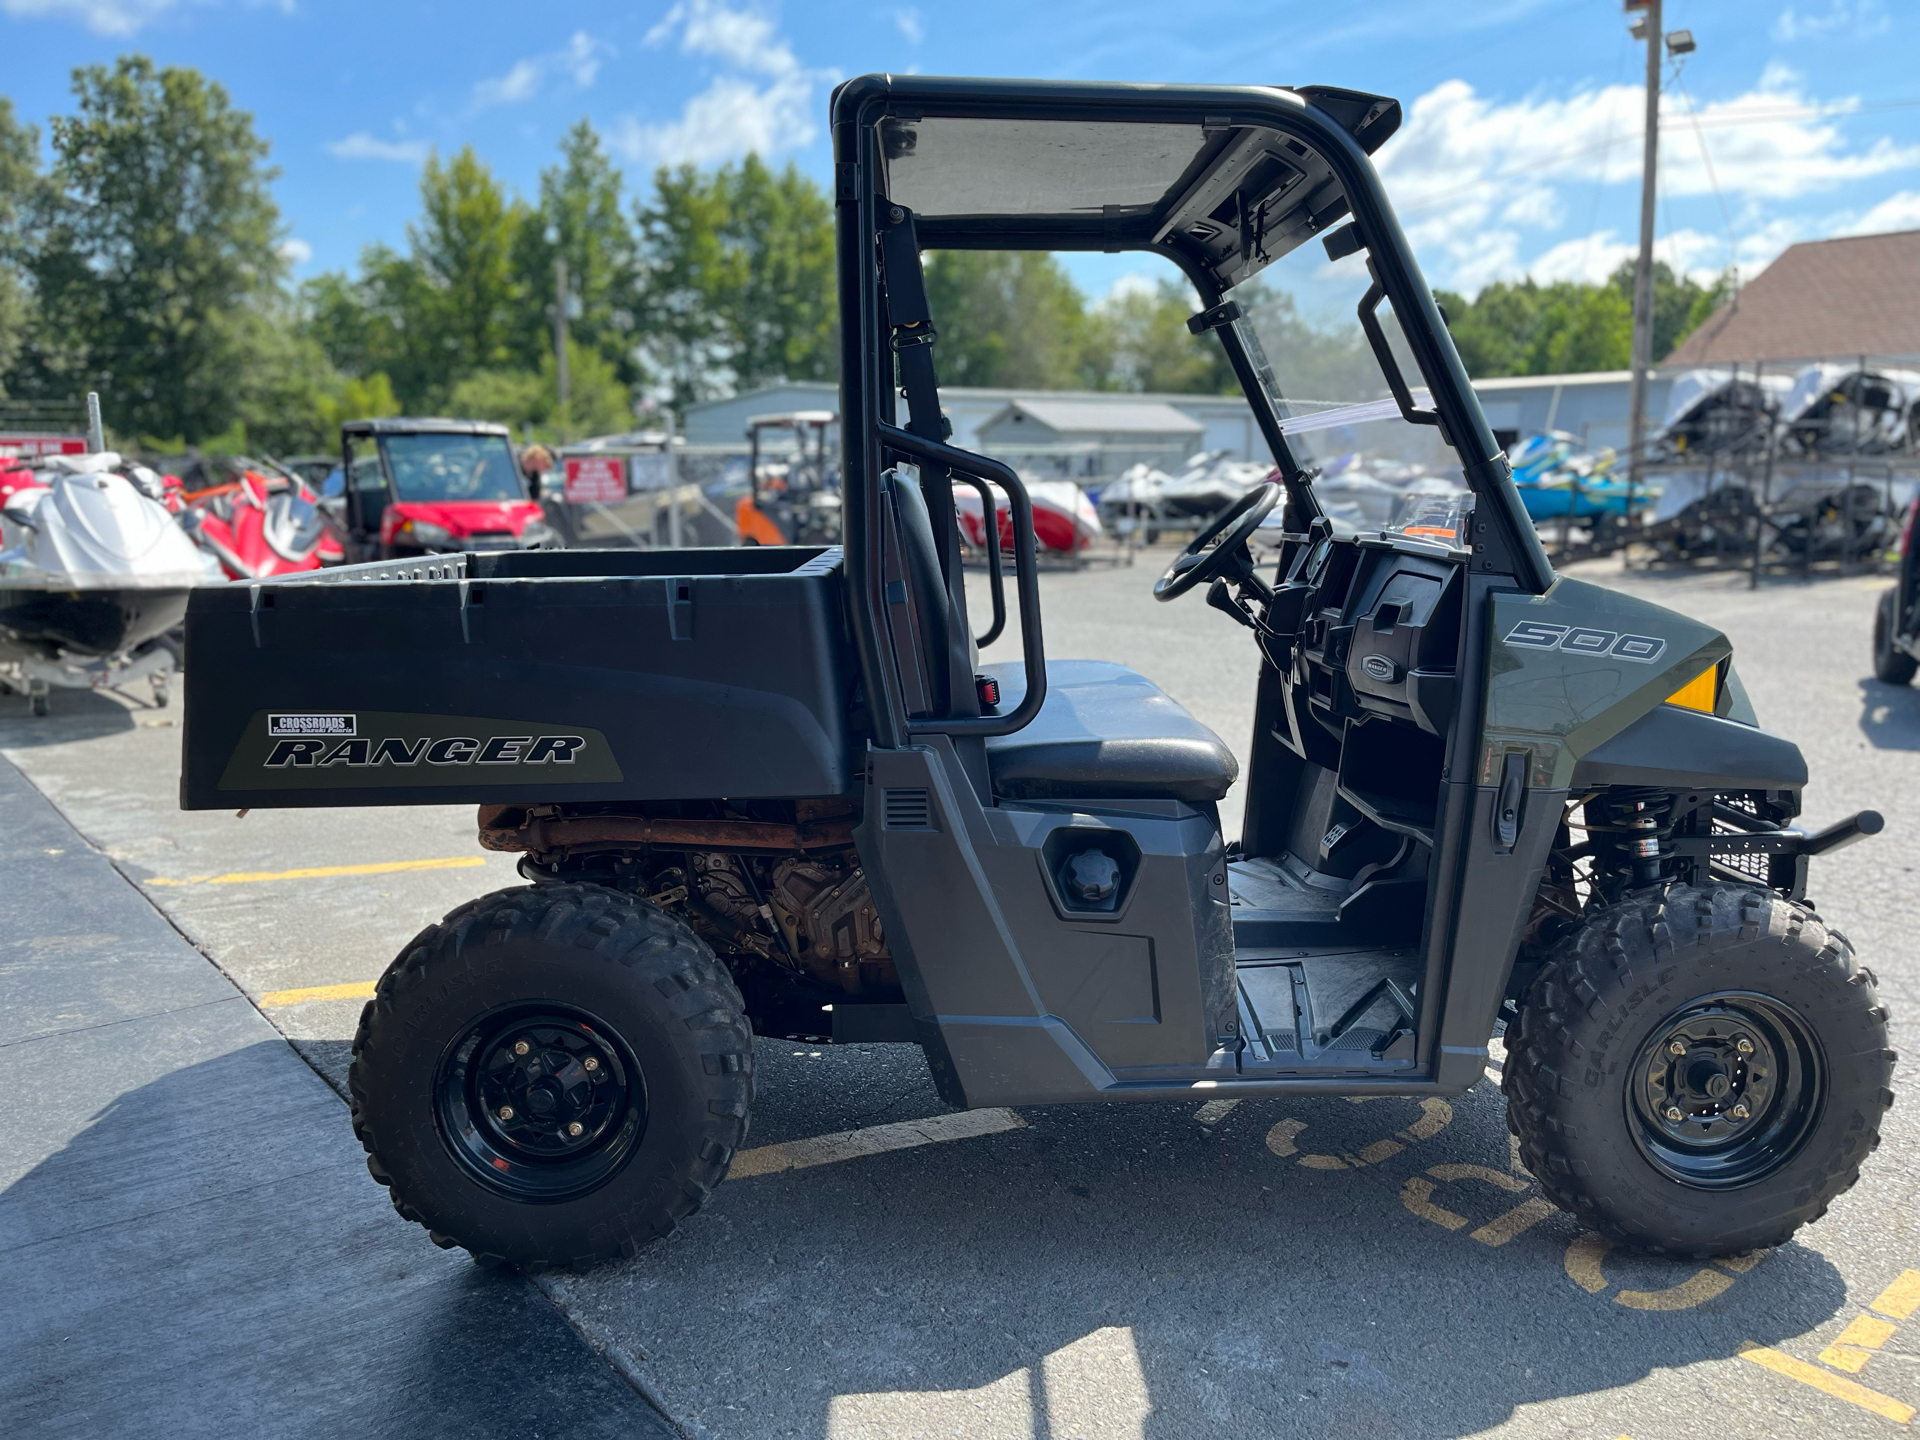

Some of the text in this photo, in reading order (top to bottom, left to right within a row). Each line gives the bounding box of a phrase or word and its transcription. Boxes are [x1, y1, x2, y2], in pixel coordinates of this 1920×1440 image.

[1502, 620, 1667, 665] 500
[279, 717, 345, 728] CROSSROADS
[263, 736, 586, 768] RANGER
[1584, 965, 1676, 1088] CARLISLE
